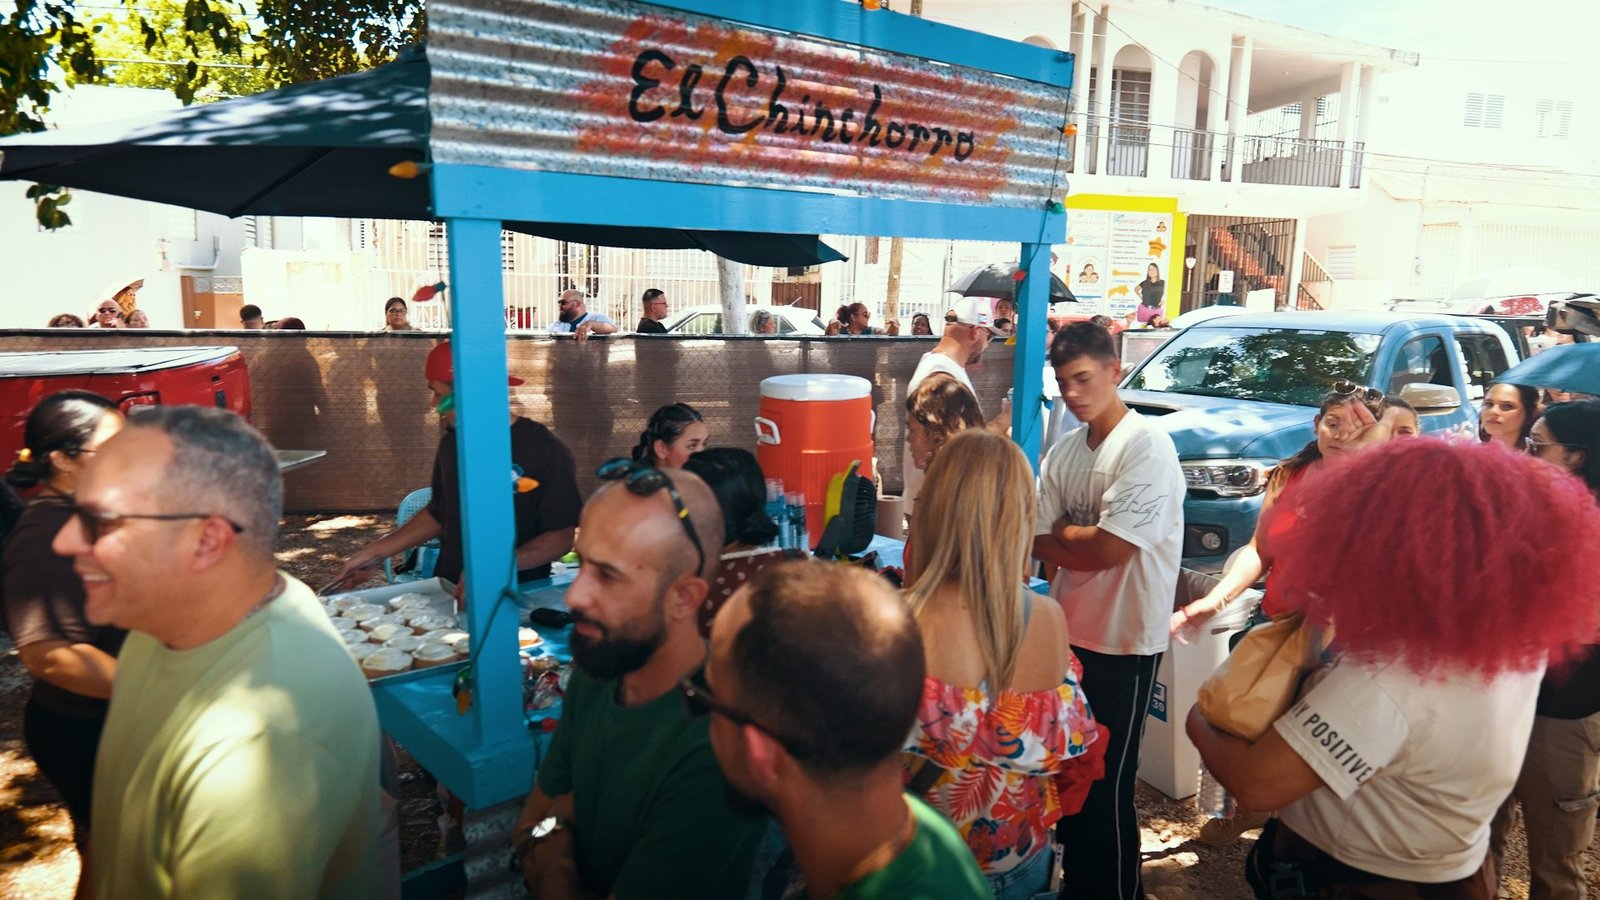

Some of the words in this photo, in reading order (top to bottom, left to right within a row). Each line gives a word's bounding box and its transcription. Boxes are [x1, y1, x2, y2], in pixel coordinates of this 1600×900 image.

[629, 51, 705, 123] El
[715, 55, 975, 163] Chinchorro
[1302, 713, 1373, 782] POSITIVE
